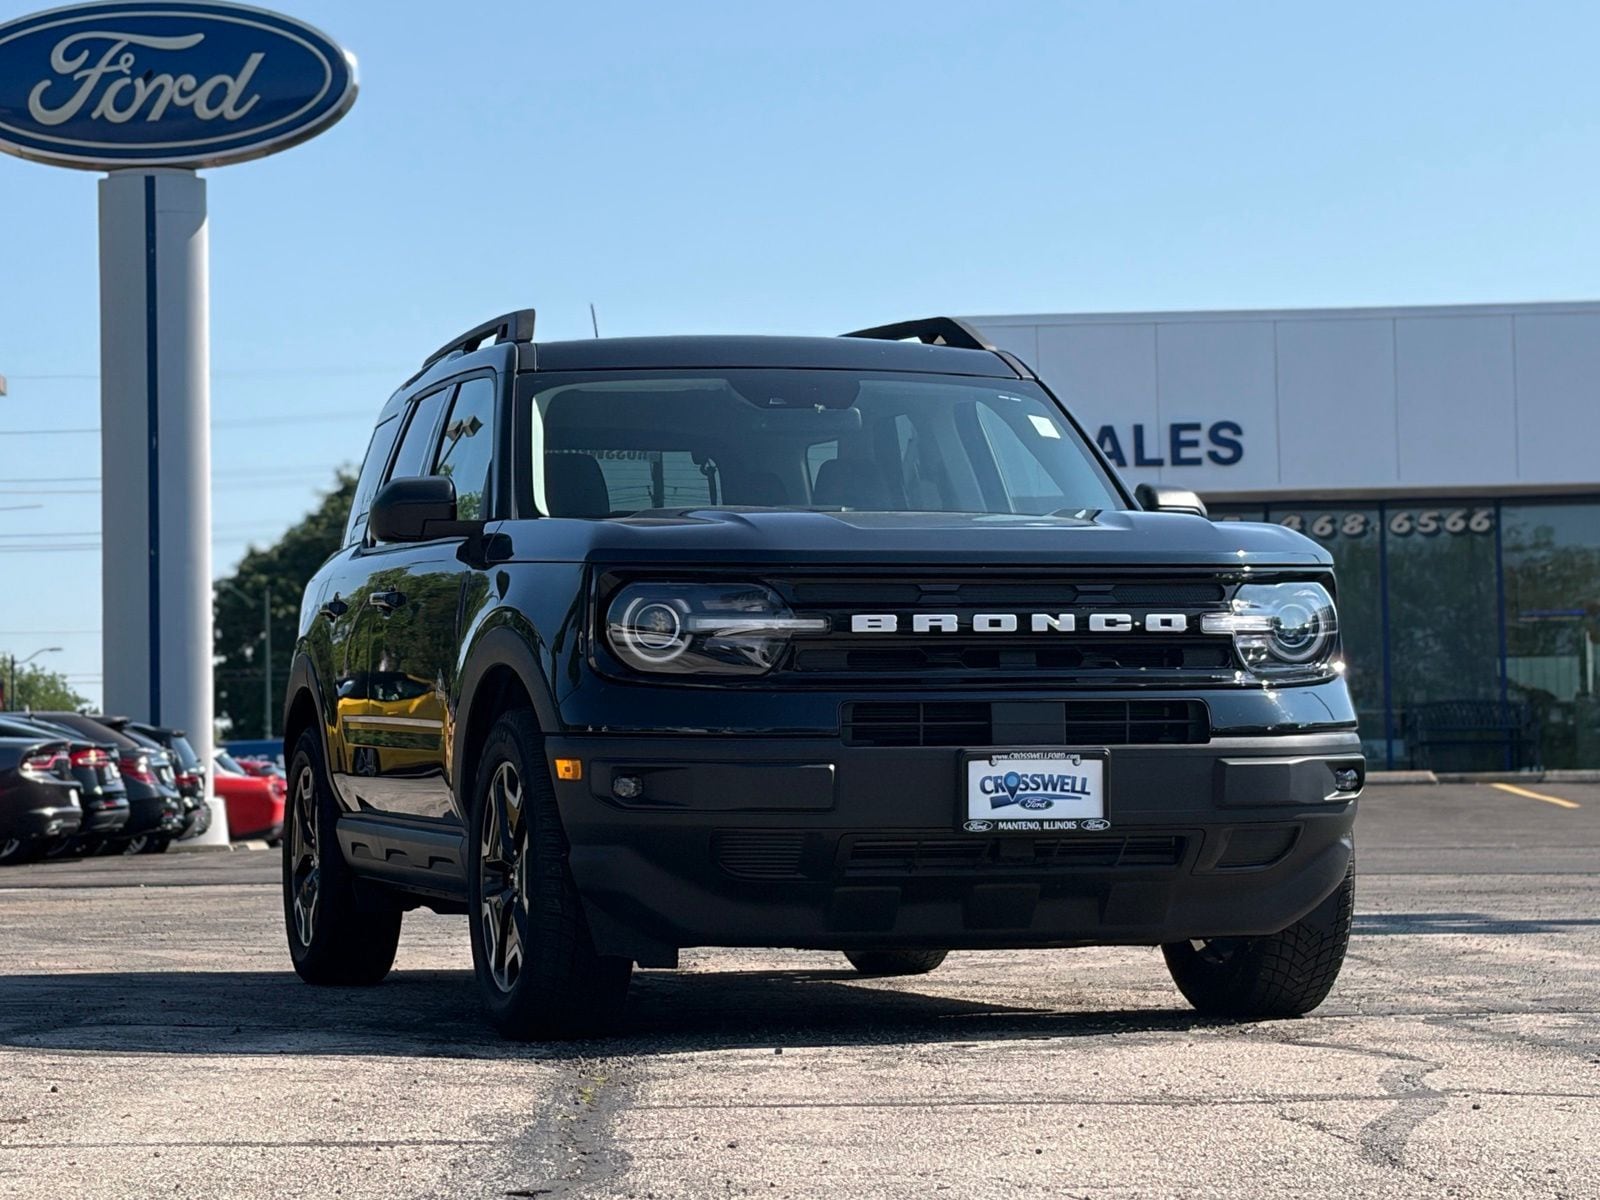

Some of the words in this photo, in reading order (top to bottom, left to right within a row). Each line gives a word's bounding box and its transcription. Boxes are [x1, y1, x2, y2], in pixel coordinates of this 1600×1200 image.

[28, 31, 265, 125] Ford
[1097, 420, 1244, 466] ALES
[1390, 509, 1491, 534] 6566
[851, 613, 1188, 632] BRONCO
[1025, 797, 1048, 809] Ford
[998, 820, 1042, 831] MANTENO,
[1043, 820, 1078, 830] ILLINOIS
